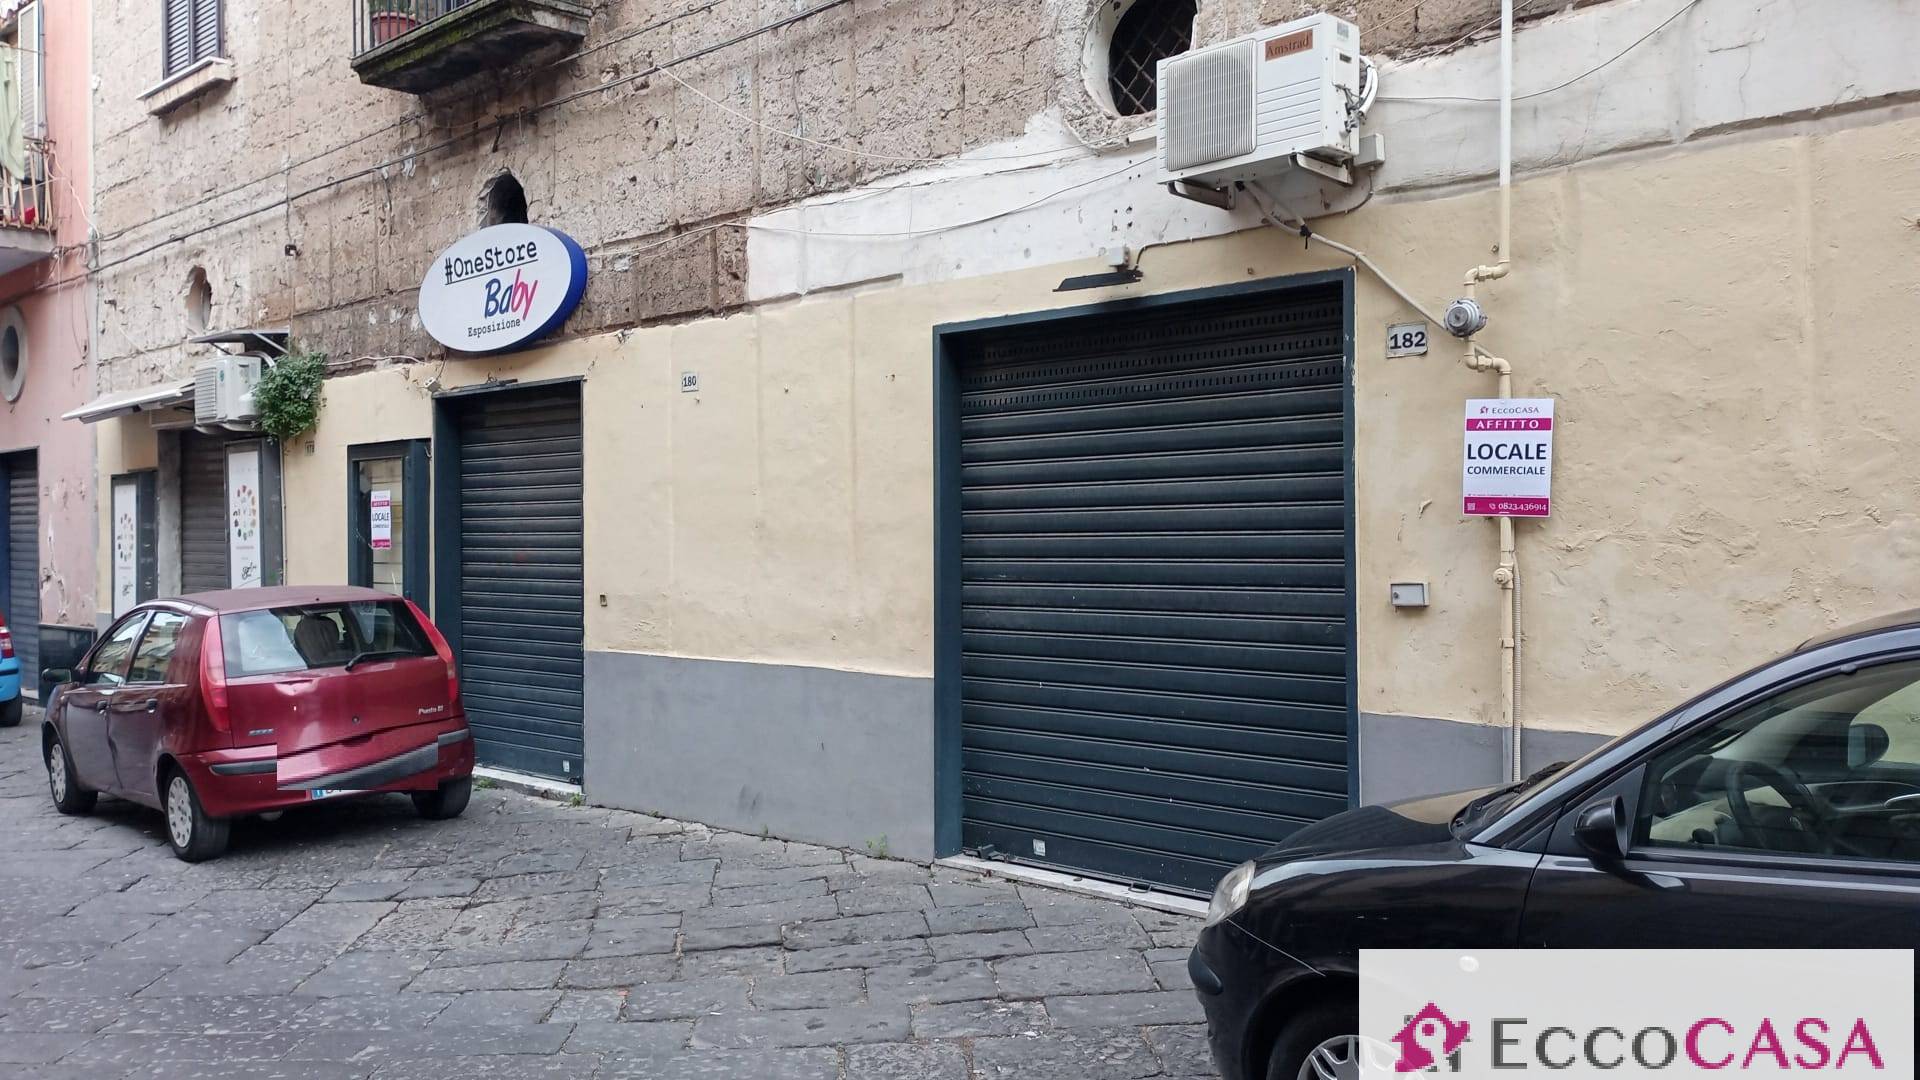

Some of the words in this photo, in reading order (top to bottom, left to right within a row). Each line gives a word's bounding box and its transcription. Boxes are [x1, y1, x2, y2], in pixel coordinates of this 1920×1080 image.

[1267, 33, 1309, 56] Amstrad
[444, 241, 538, 284] #OneStore
[484, 268, 538, 321] Baby
[468, 317, 521, 338] Esposizione
[1389, 331, 1426, 350] 182
[683, 375, 697, 387] 180
[1476, 420, 1540, 429] AFFITTO
[1467, 443, 1547, 459] LOCALE
[1467, 466, 1546, 475] COMMERCIALE
[372, 512, 390, 521] LOCALE
